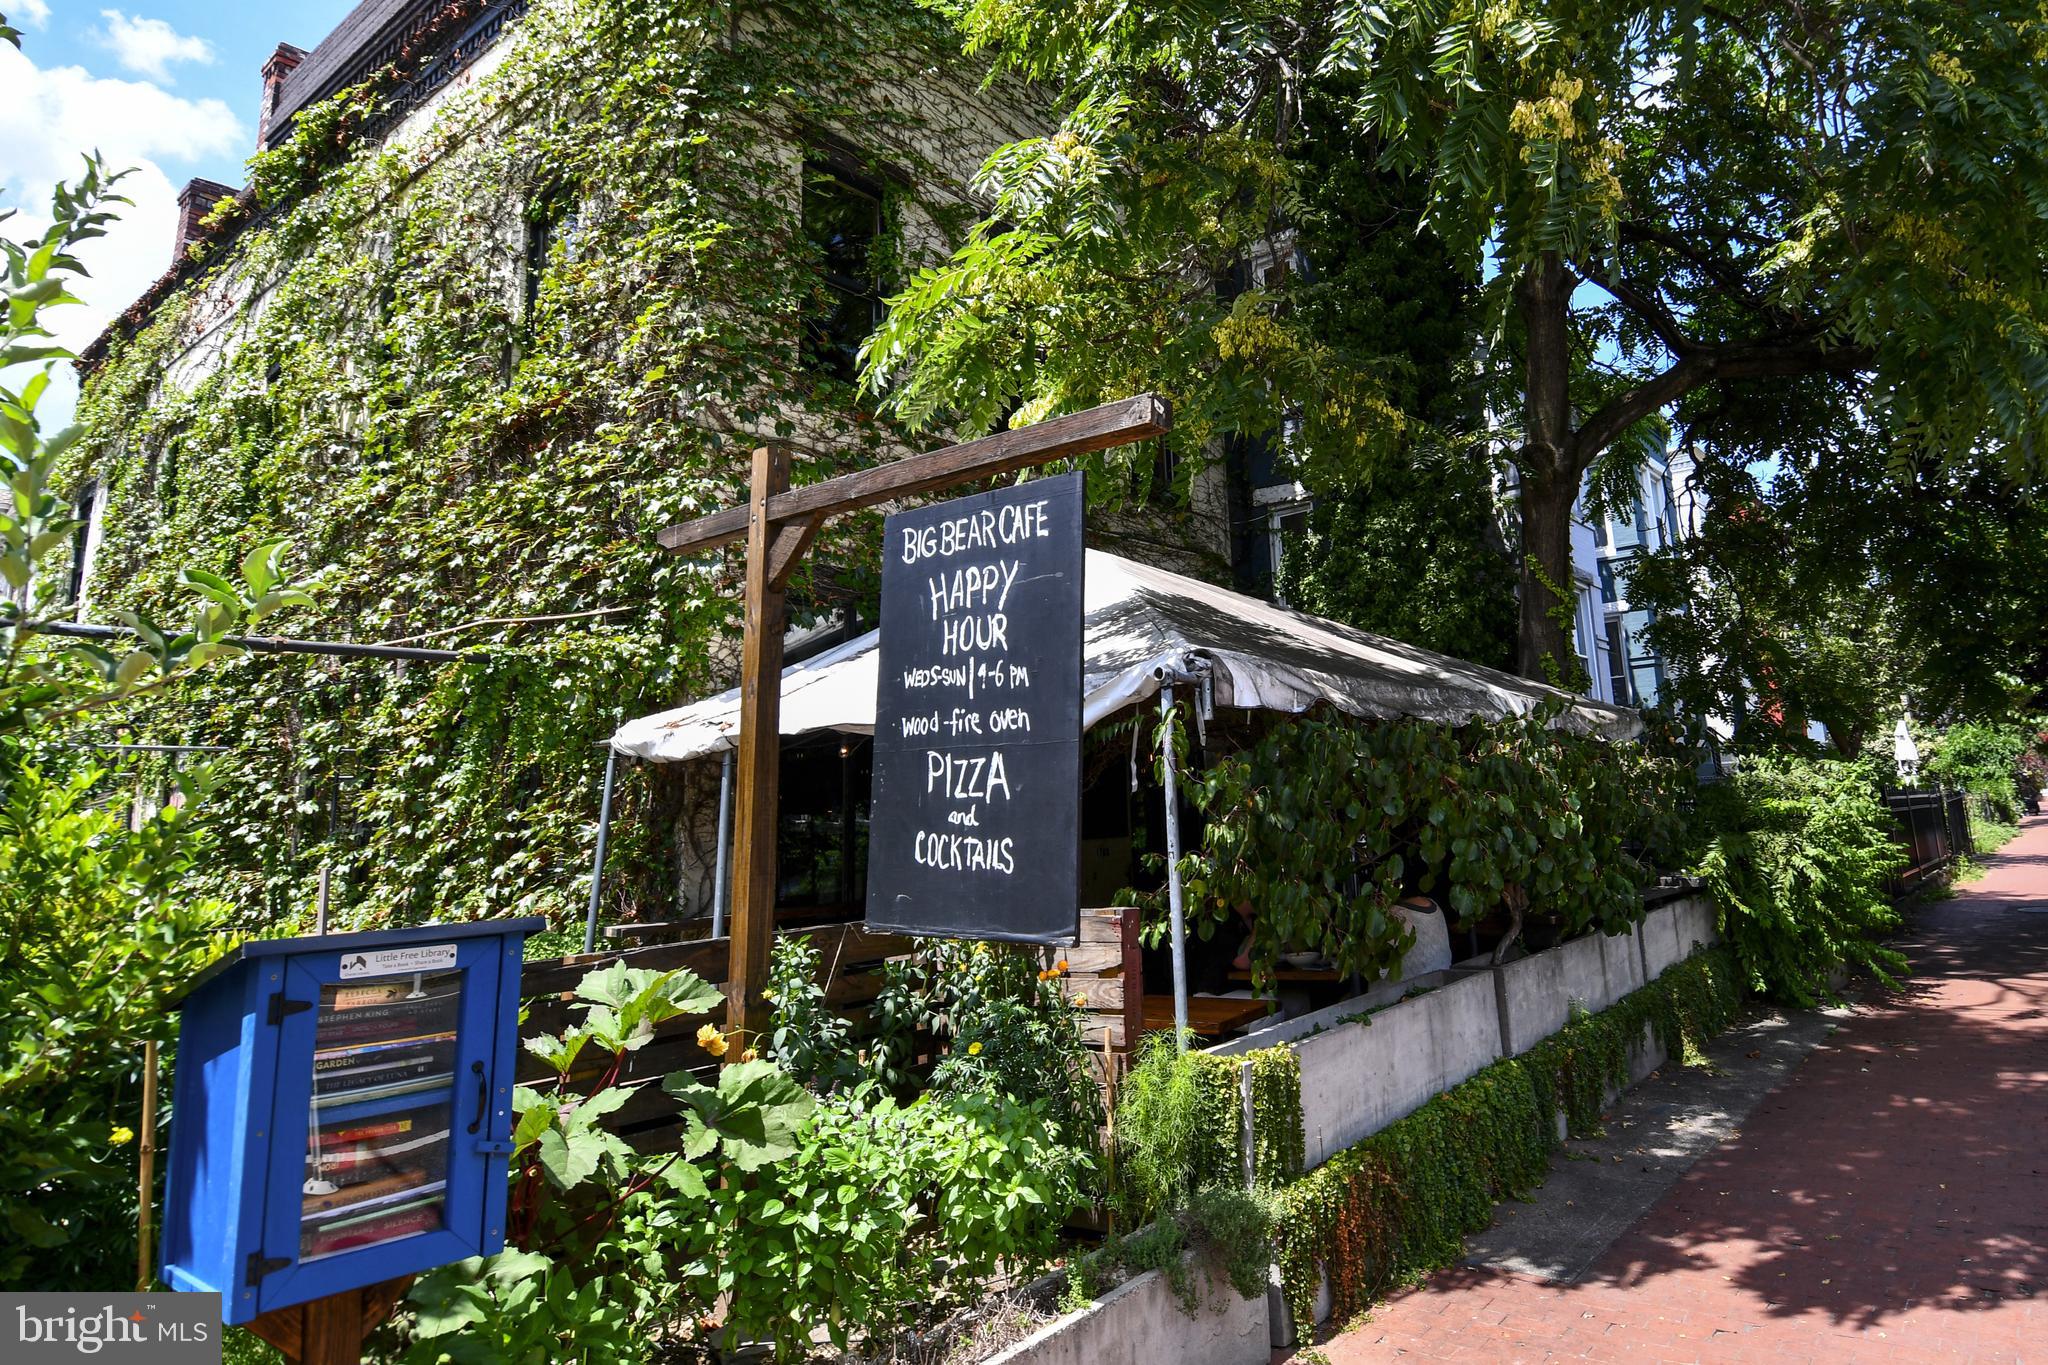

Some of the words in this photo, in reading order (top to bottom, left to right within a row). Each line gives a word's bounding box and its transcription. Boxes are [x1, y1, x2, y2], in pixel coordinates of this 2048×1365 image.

[902, 527, 937, 564] BIG
[940, 510, 997, 556] BEAR
[999, 501, 1049, 544] CAFE
[929, 560, 1019, 621] HAPPY
[943, 613, 1008, 656] HOUR
[904, 664, 966, 689] WEDS-SUN
[978, 660, 1004, 689] 4-6
[1010, 664, 1030, 689] PM
[989, 708, 1031, 733] oven
[927, 751, 1011, 804] PIZZA
[948, 804, 979, 827] and
[914, 831, 1014, 874] COCKTAILS
[375, 953, 398, 963] Little
[400, 951, 419, 960] Free
[421, 949, 451, 959] Library
[318, 1013, 362, 1023] STEPHEN
[364, 1009, 389, 1018] KING
[316, 1057, 355, 1070] GARDEN
[383, 1215, 424, 1229] SILENCE
